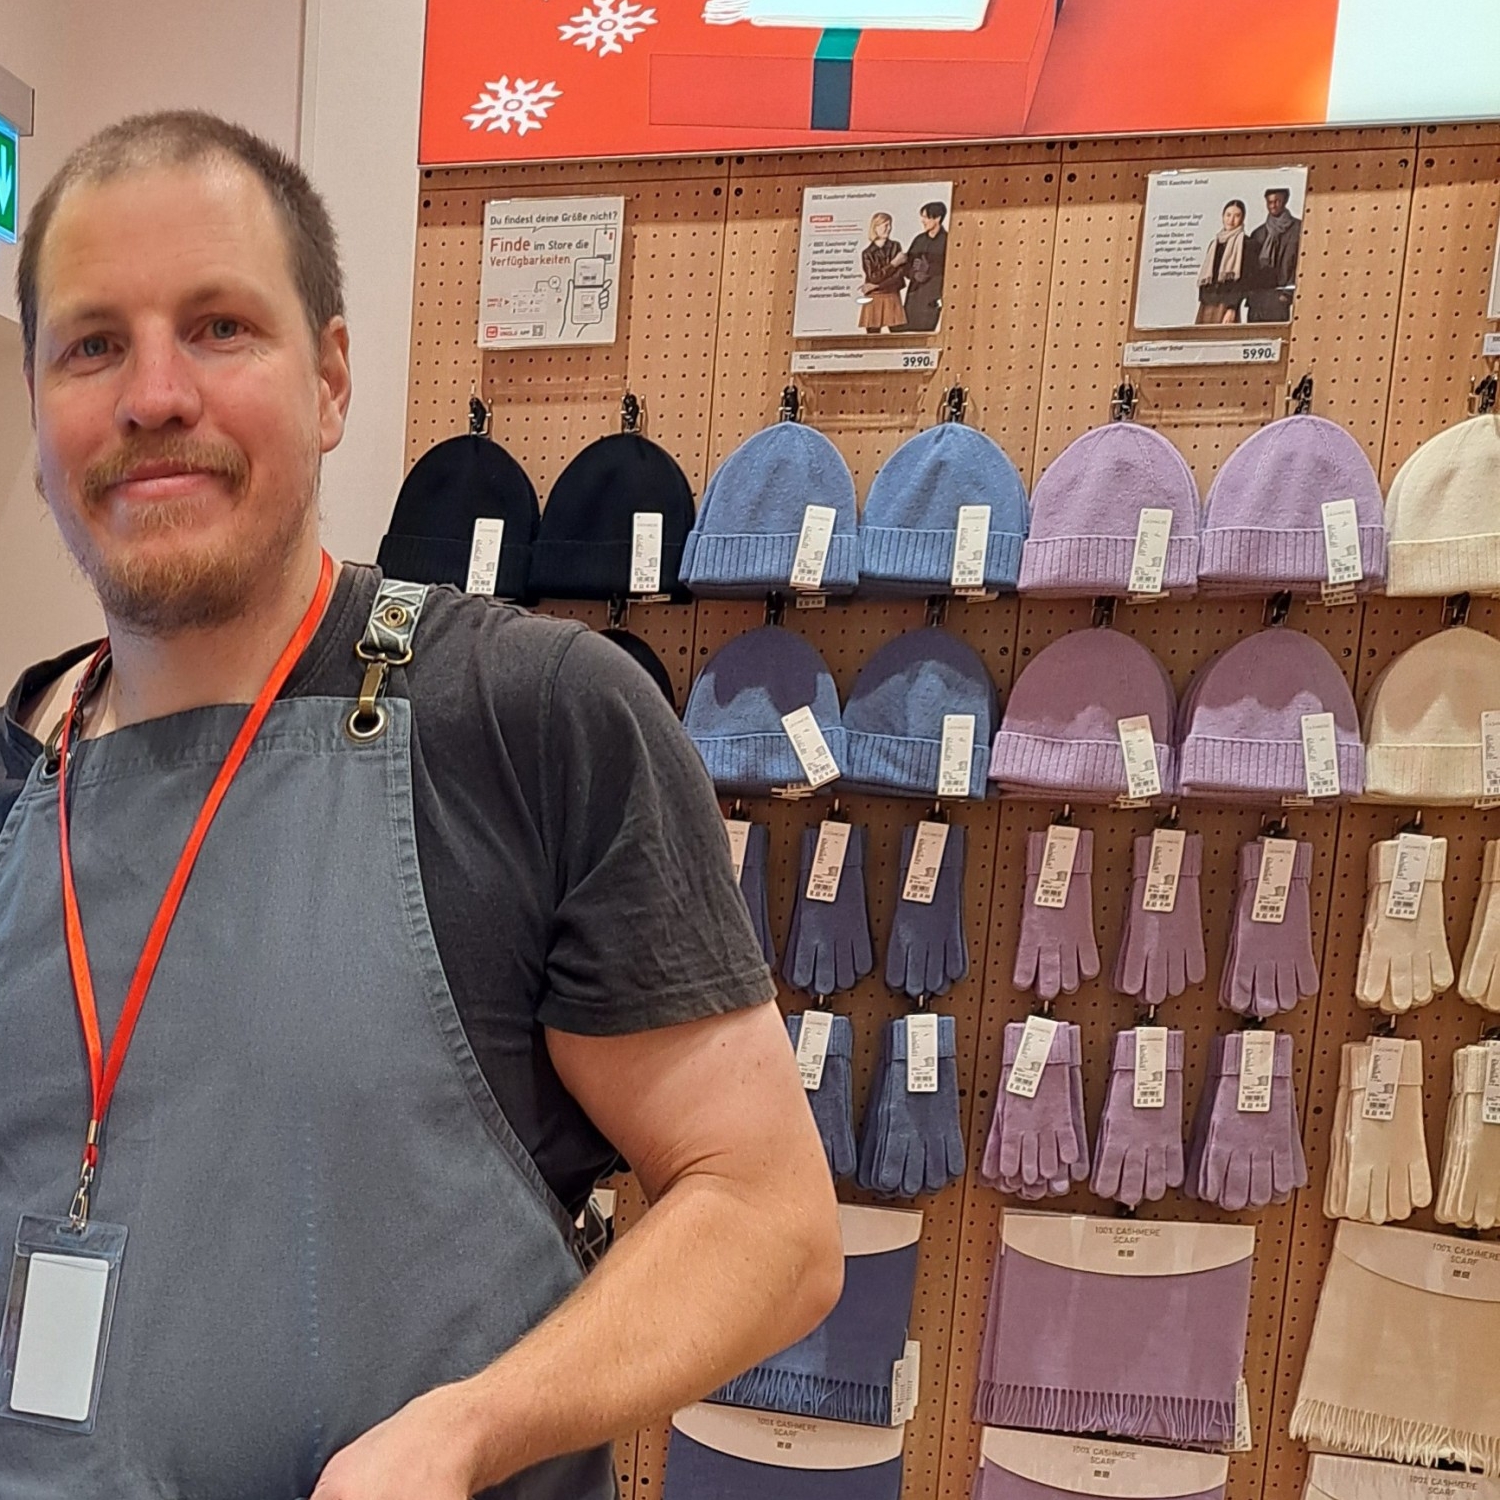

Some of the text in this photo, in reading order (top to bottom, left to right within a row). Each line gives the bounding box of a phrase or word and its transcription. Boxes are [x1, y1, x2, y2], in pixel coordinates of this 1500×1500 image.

[490, 216, 502, 226] Du
[504, 214, 533, 225] findest
[536, 213, 559, 223] deine
[590, 210, 618, 221] nicht?
[489, 236, 589, 253] Finde im Store die
[489, 254, 571, 269] Verfügbarkeiten
[1115, 1227, 1161, 1237] CASHMERE
